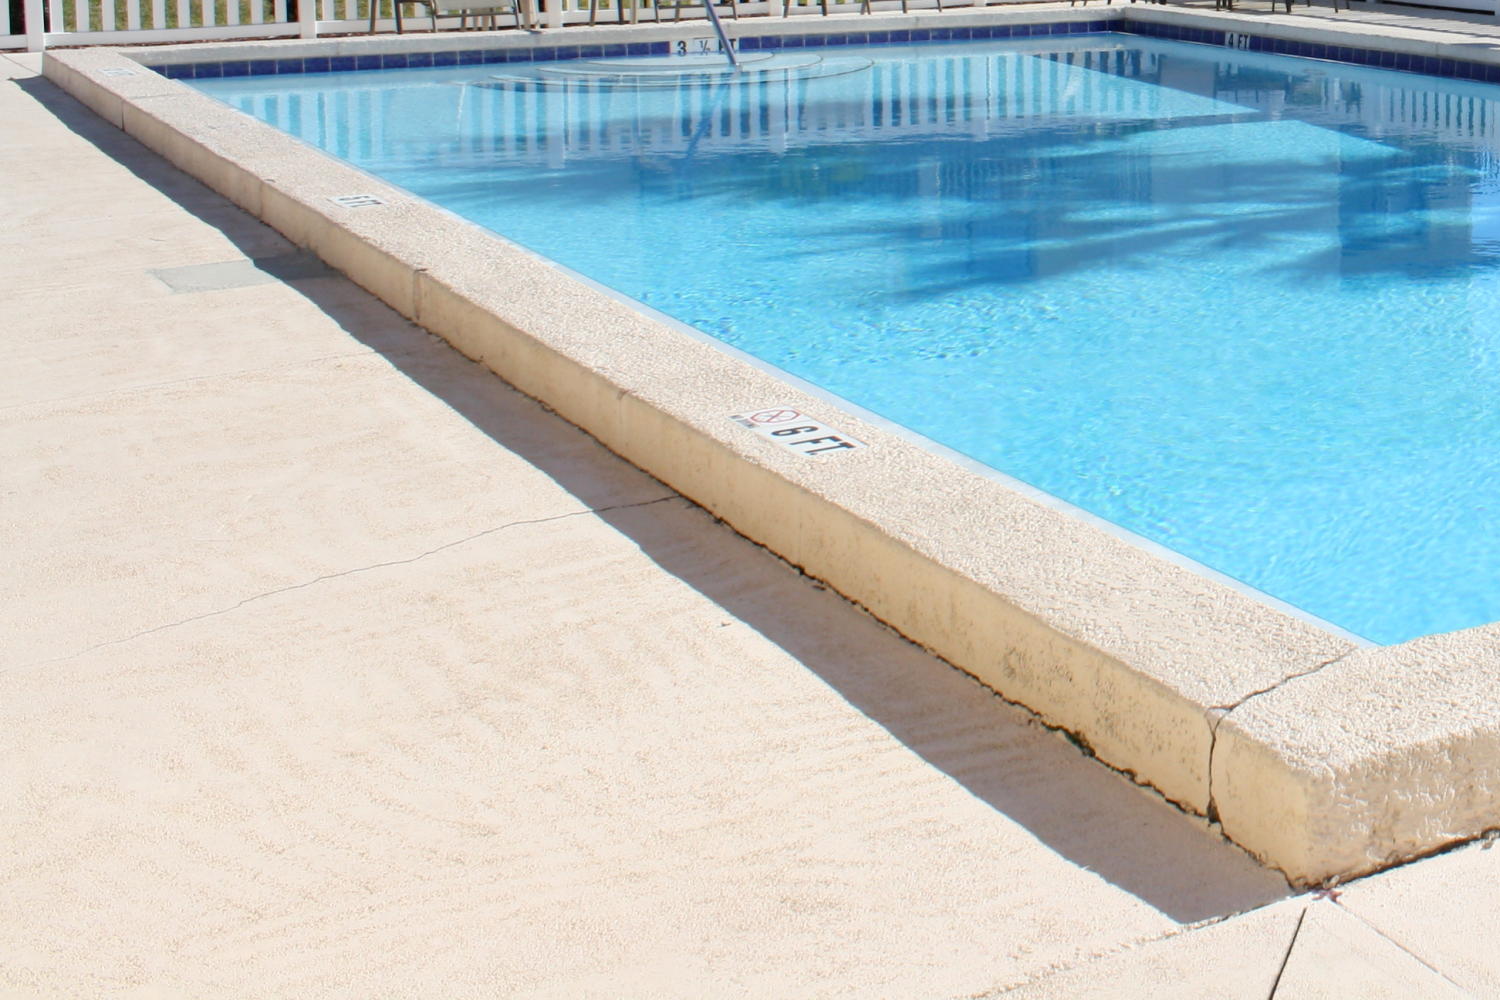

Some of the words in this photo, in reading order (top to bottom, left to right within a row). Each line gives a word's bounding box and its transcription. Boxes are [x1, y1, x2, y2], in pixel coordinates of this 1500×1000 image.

[677, 40, 687, 56] 3
[1229, 32, 1234, 46] 4
[1238, 33, 1249, 49] FT
[771, 425, 819, 437] 6
